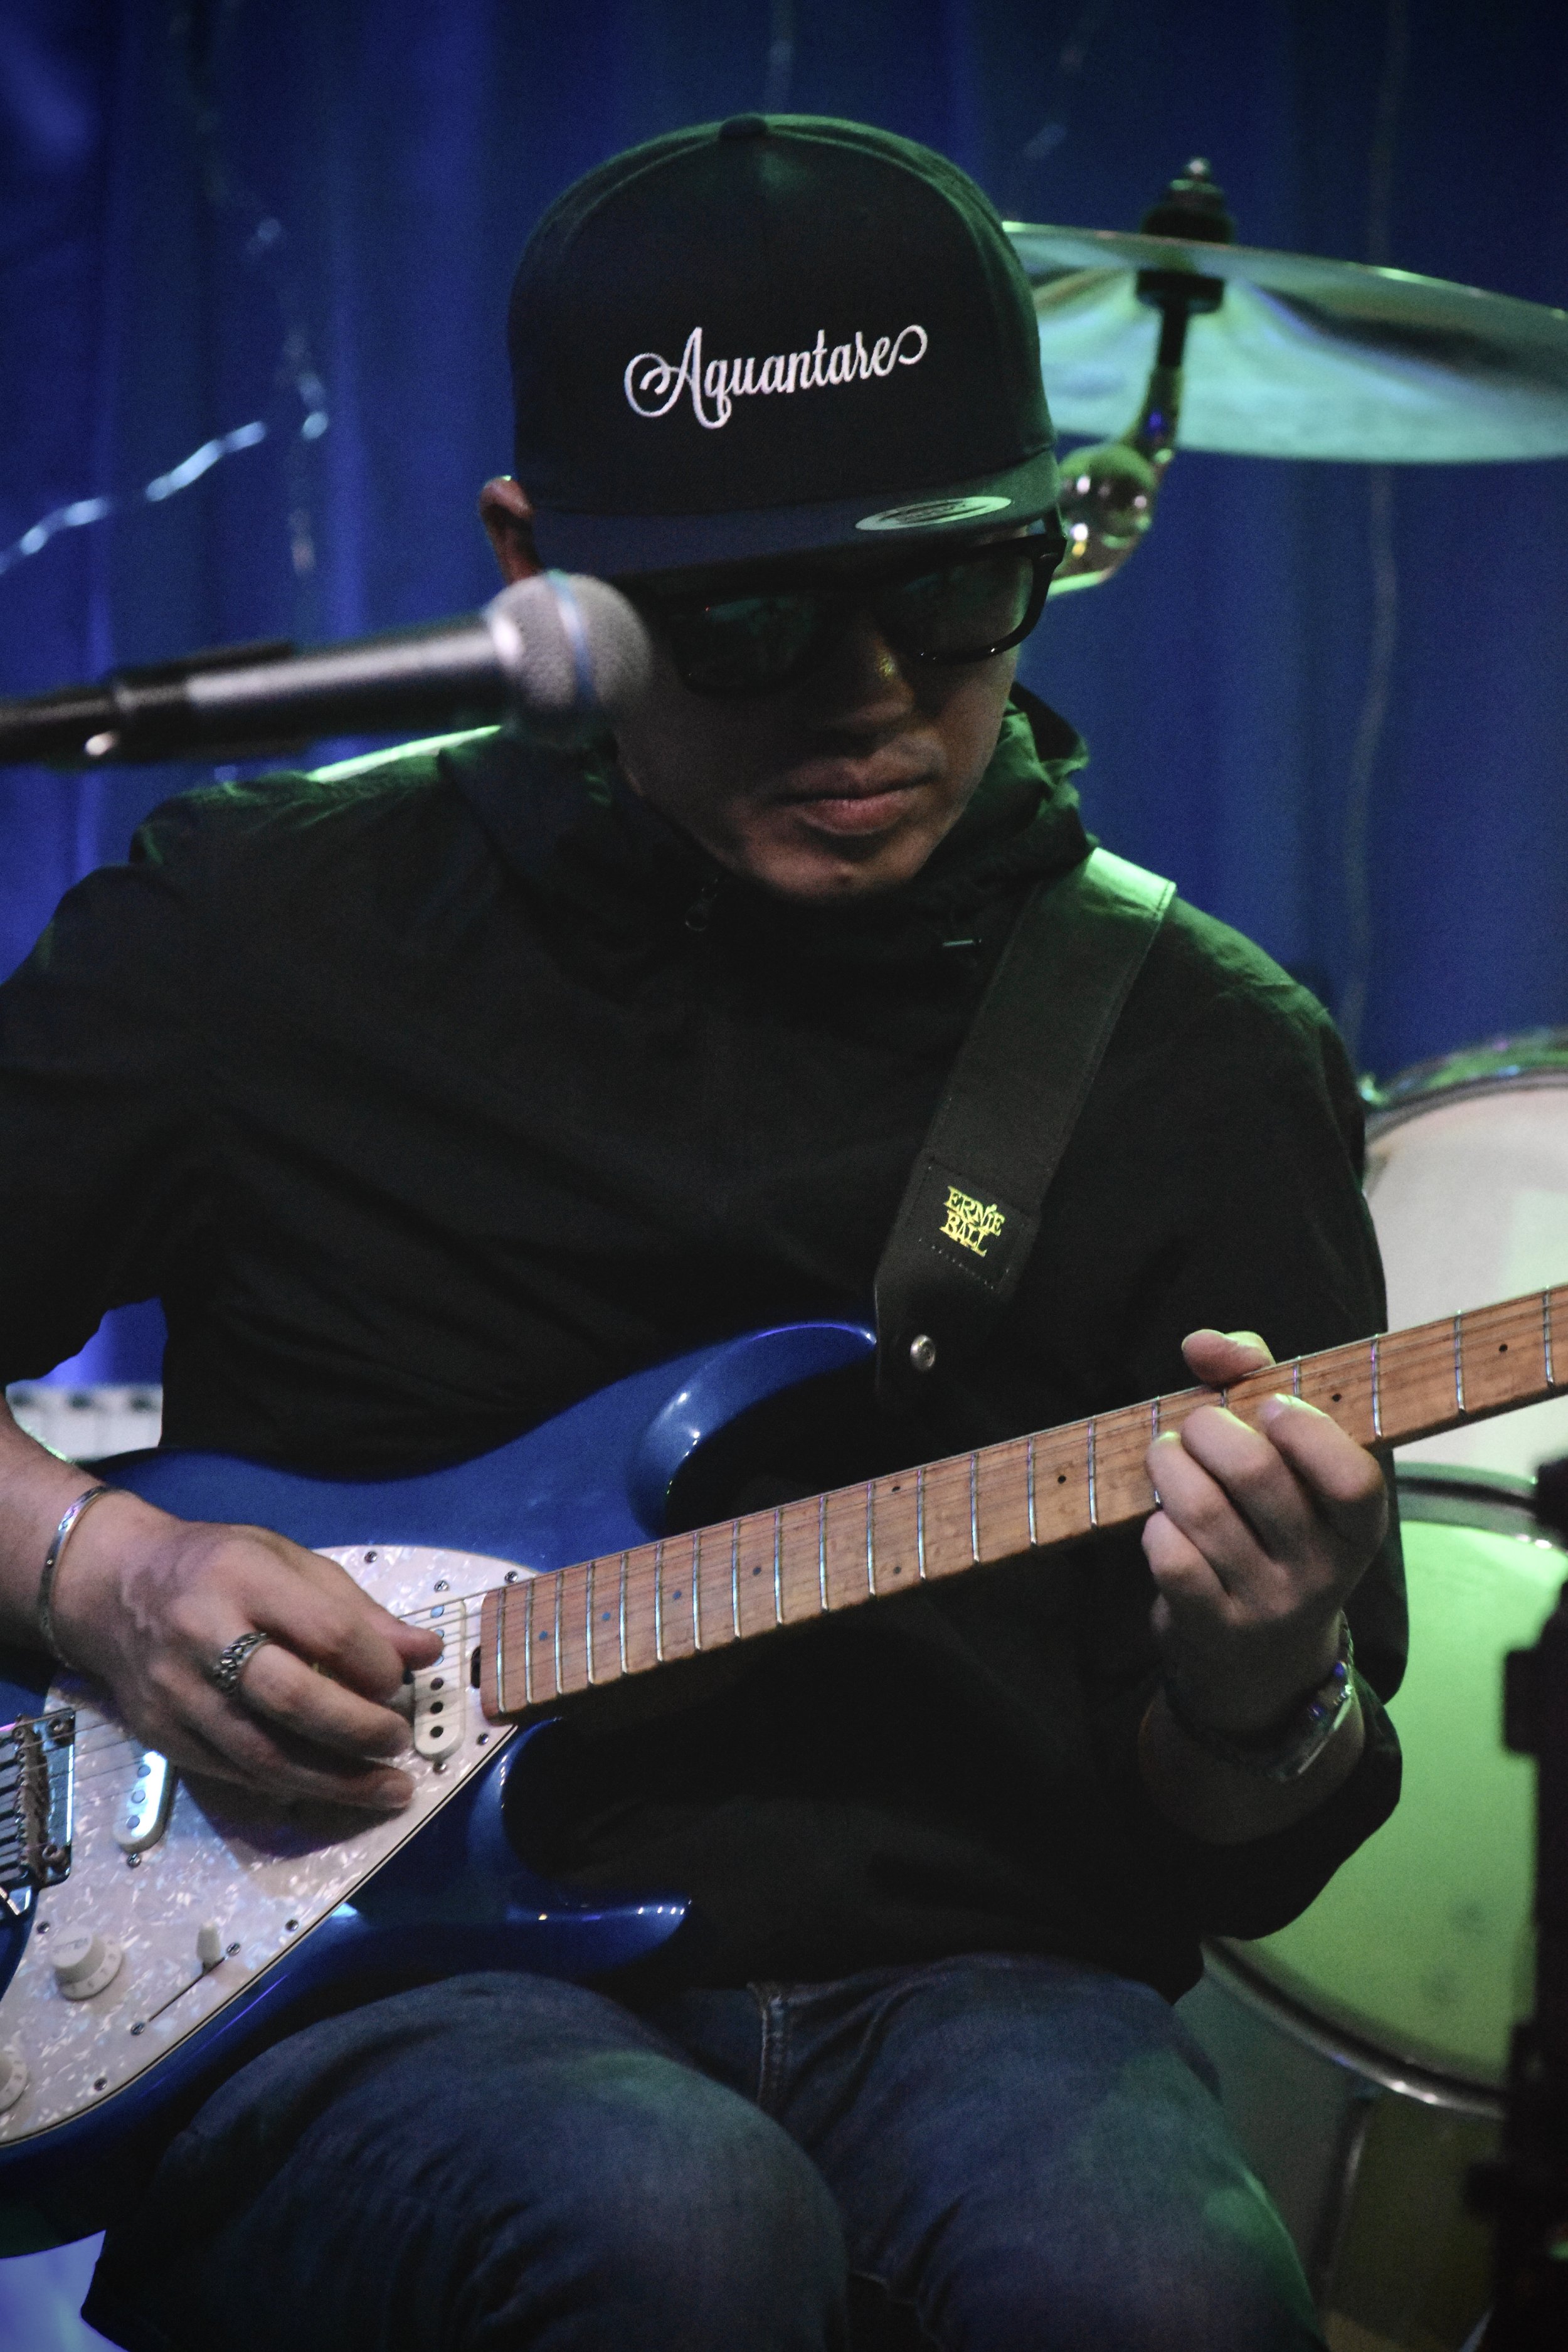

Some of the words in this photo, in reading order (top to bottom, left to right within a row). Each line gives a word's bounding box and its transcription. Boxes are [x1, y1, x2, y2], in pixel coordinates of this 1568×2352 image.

[624, 324, 928, 429] Aquantare
[939, 1209, 988, 1258] BALL
[943, 1185, 1005, 1237] ERNIE
